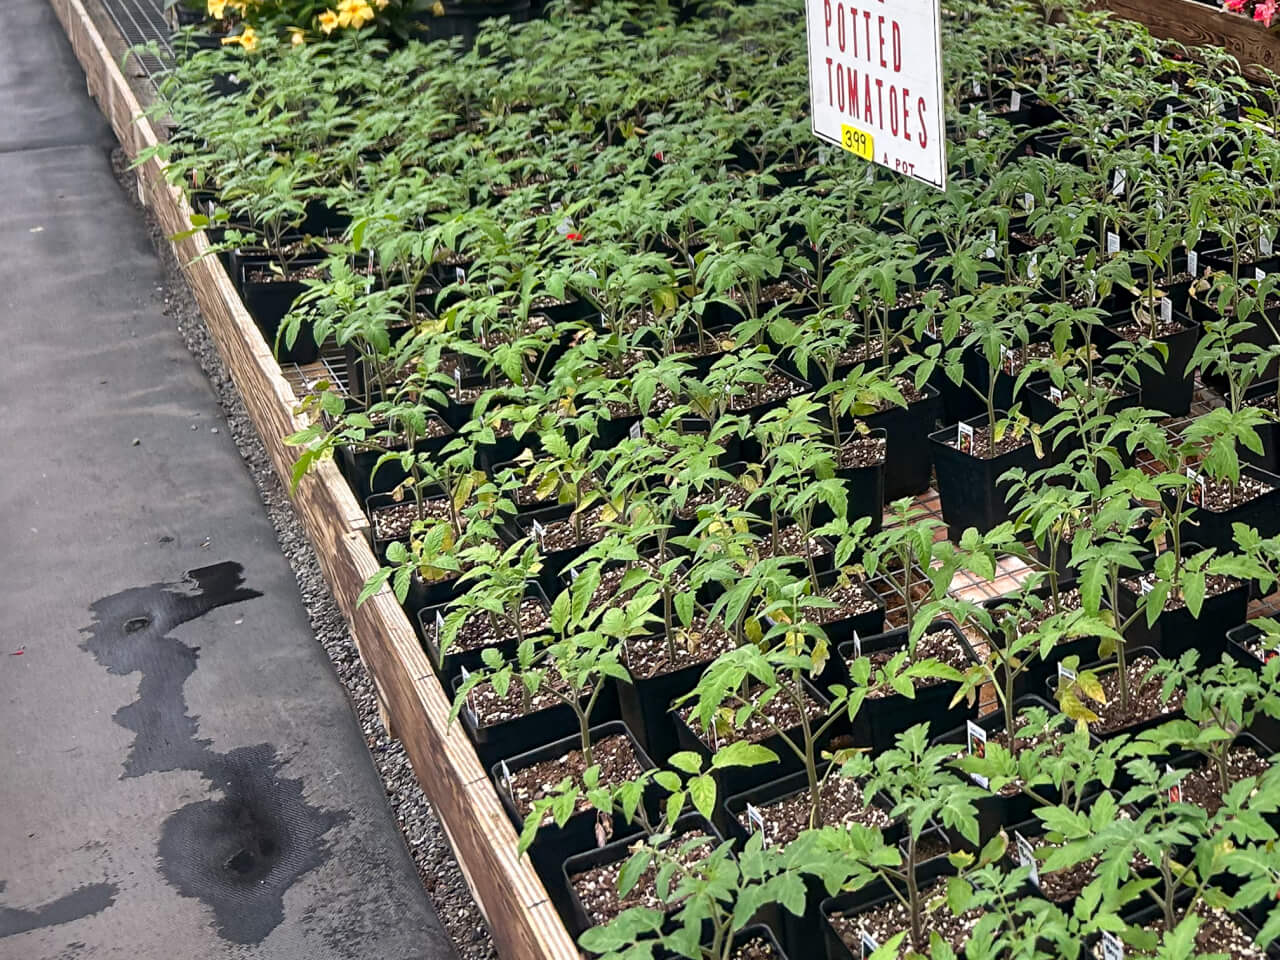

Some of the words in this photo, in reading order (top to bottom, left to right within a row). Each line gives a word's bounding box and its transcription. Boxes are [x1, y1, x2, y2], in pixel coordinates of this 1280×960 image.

[825, 57, 928, 149] TOMATOES
[883, 152, 889, 165] A
[895, 158, 915, 176] POT
